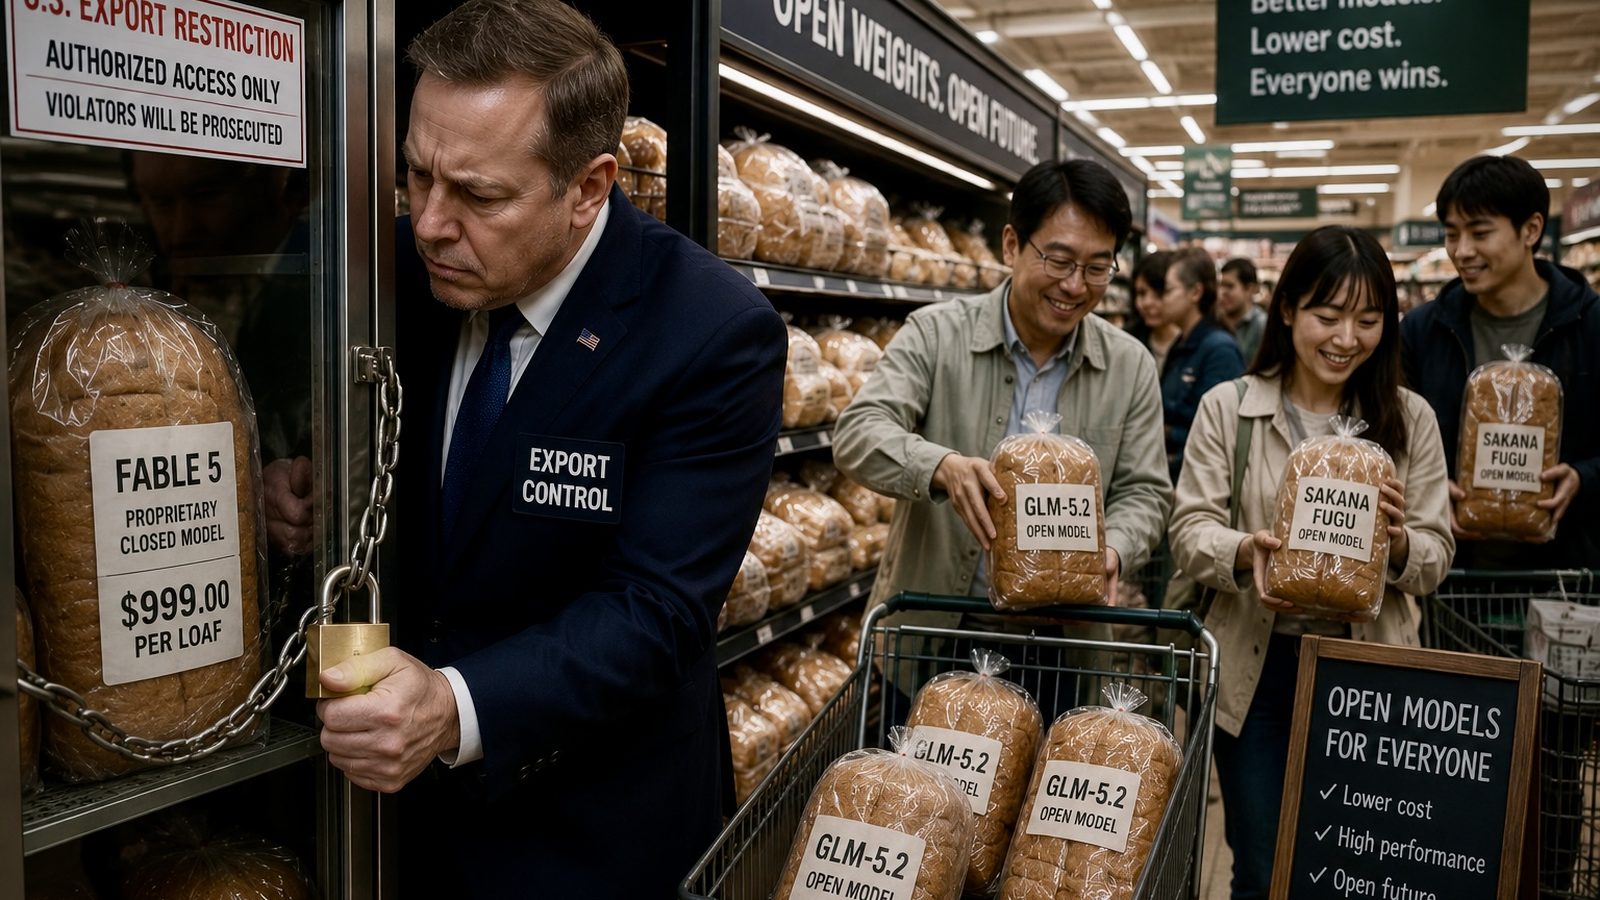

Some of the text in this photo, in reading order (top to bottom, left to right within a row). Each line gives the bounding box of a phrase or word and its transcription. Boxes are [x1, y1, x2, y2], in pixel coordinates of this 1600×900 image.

[80, 0, 166, 36] EXPORT
[174, 8, 294, 63] RESTRICTION
[1251, 20, 1402, 55] Lower cost.
[46, 39, 280, 105] AUTHORIZED ACCESS ONLY
[851, 7, 945, 114] WEIGHTS.
[947, 72, 989, 139] OPEN
[1250, 60, 1448, 100] Everyone wins.
[46, 91, 283, 146] VIOLATORS WILL BE PROSECUTED
[1483, 432, 1538, 450] SAKANA
[115, 451, 222, 493] FABLE 5
[529, 447, 610, 479] EXPORT
[1480, 469, 1536, 483] OPEN MODEL
[1491, 451, 1527, 467] FUGU
[522, 479, 613, 512] CONTROL
[1024, 496, 1091, 517] GLM-5.2
[1304, 486, 1369, 512] SAKANA
[126, 500, 217, 528] PROPRIETARY
[1312, 508, 1356, 529] FUGU
[121, 524, 225, 555] CLOSED MODEL
[1026, 524, 1091, 539] OPEN MODEL
[1298, 528, 1365, 550] OPEN MODEL
[121, 579, 230, 631] $999.00
[135, 619, 222, 658] PER LOAF
[1328, 686, 1501, 739] OPEN MODELS
[914, 739, 989, 774] GLM-5.2
[1325, 728, 1492, 783] FOR EVERYONE
[954, 777, 979, 797] DEL
[1046, 774, 1127, 809] GLM-5.2
[1343, 784, 1433, 820] Lower cost
[1040, 806, 1118, 834] OPEN MODEL
[815, 833, 909, 881] GLM-5.2
[1338, 825, 1486, 874] High performance
[806, 871, 844, 896] OPEN
[1333, 868, 1376, 898] Open
